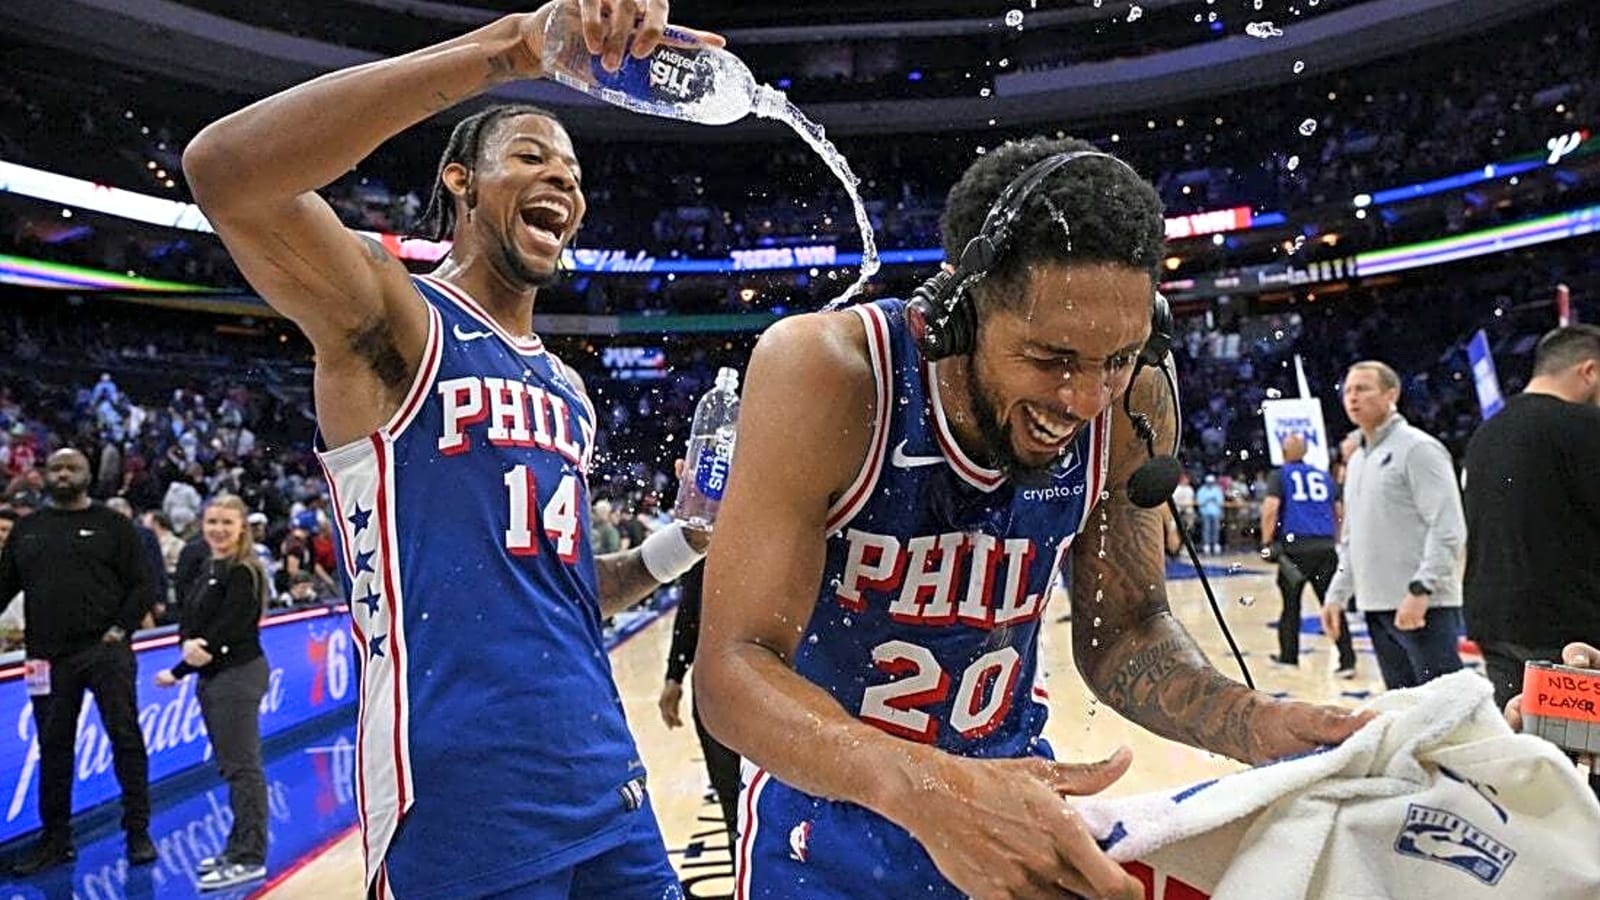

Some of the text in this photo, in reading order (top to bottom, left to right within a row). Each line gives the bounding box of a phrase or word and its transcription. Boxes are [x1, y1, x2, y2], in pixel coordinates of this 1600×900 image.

[794, 245, 836, 267] WIN
[1275, 429, 1319, 447] WN
[1291, 470, 1329, 502] 16
[503, 464, 581, 565] 14
[859, 639, 1022, 744] 20
[1538, 693, 1597, 716] PLAYER
